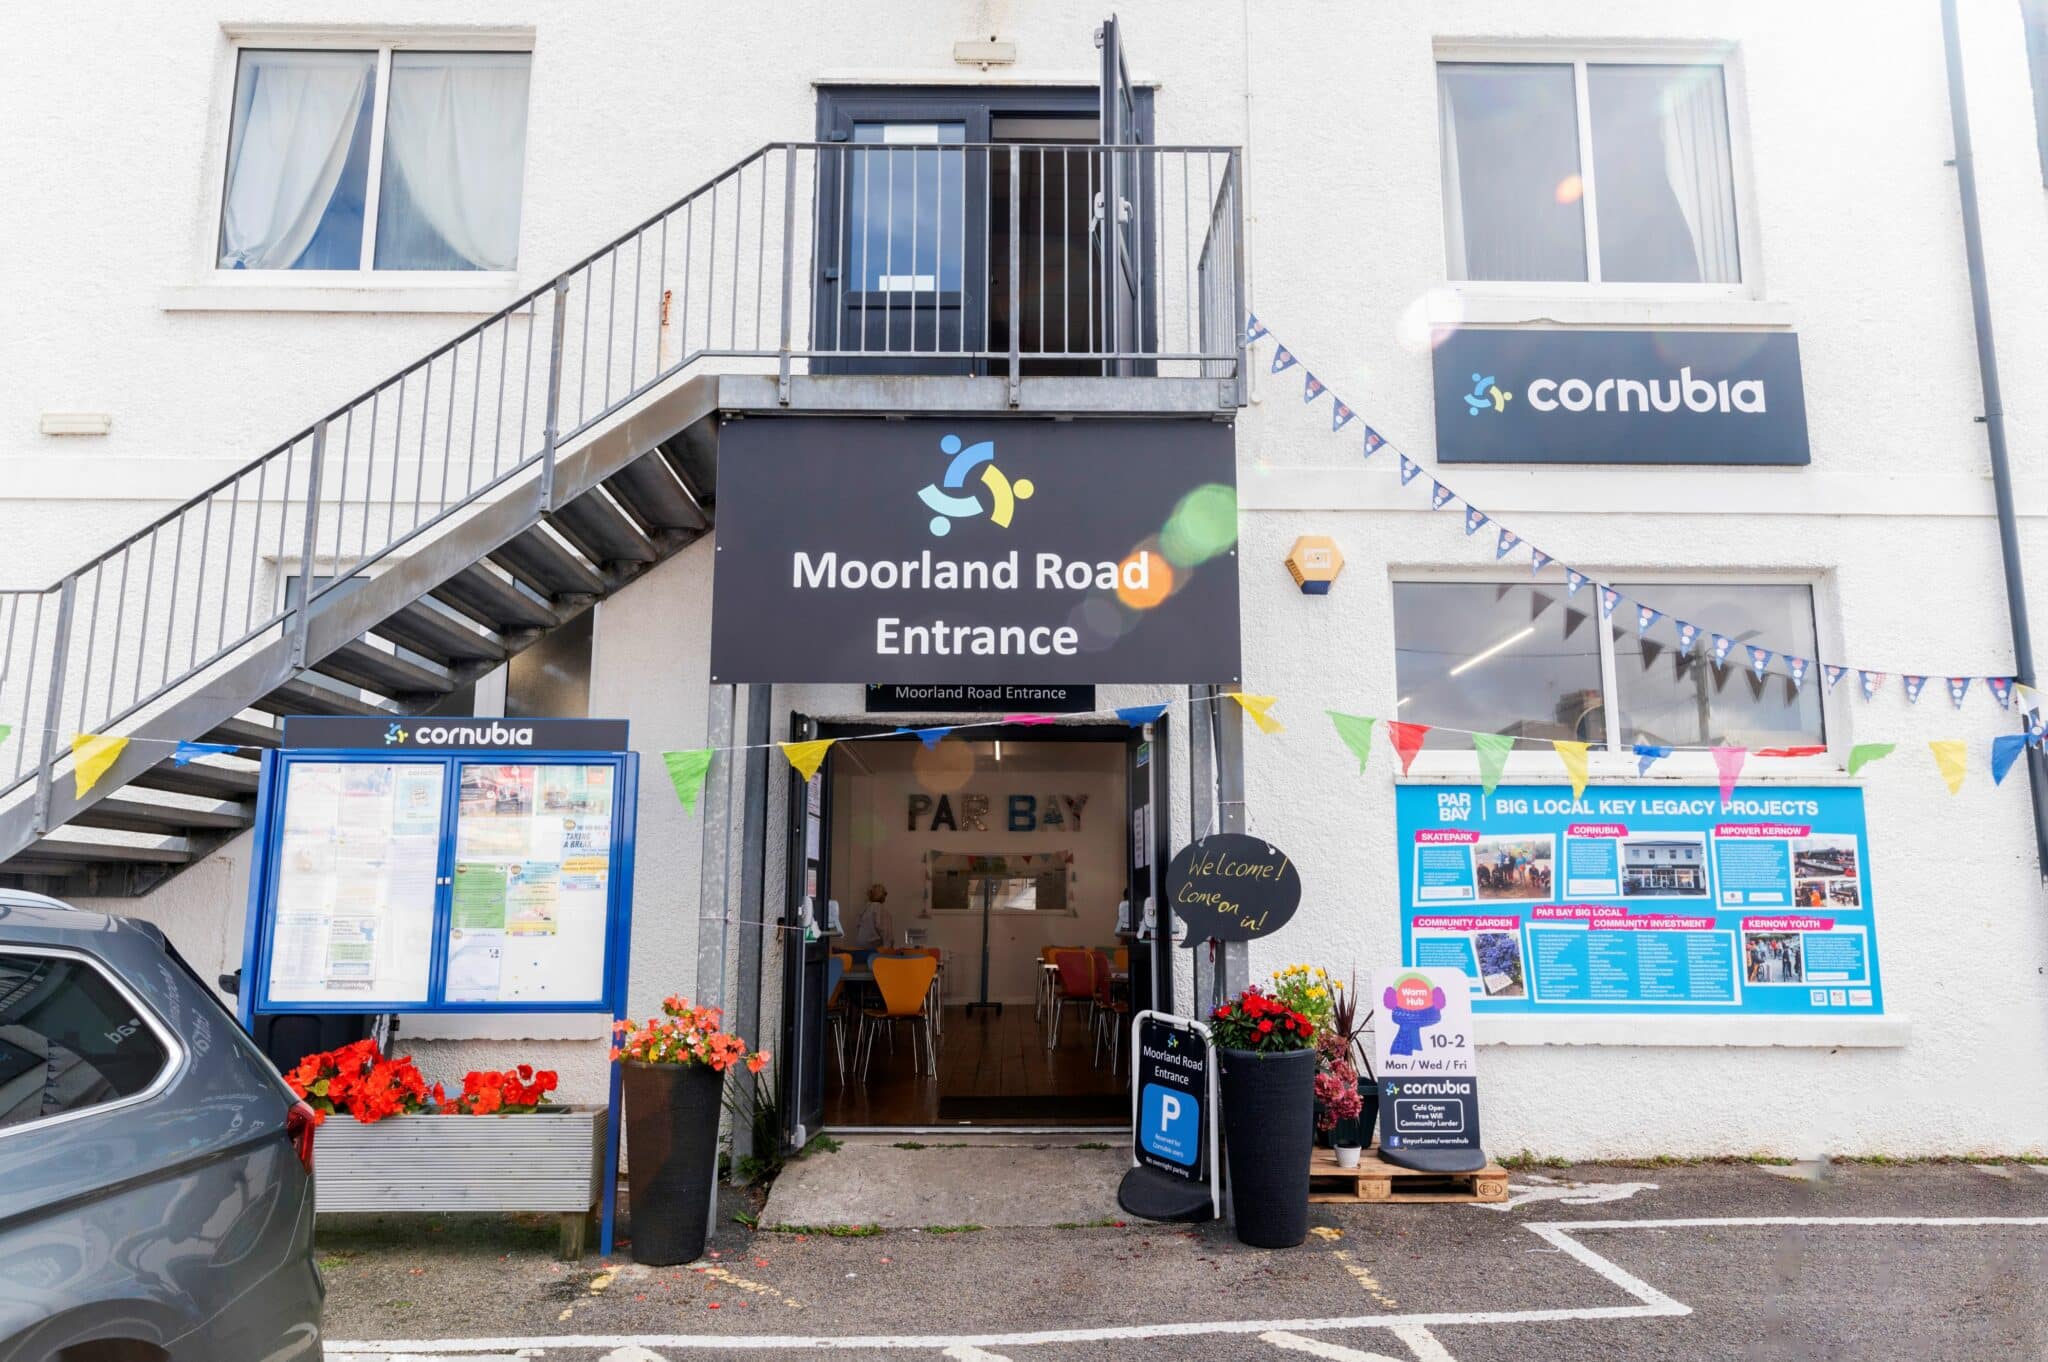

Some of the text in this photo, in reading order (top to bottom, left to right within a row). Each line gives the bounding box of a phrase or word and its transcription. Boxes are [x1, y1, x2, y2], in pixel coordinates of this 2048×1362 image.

[1527, 366, 1767, 414] cornubia
[792, 551, 1150, 590] Moorland Road
[876, 617, 1079, 656] Entrance
[895, 686, 1067, 699] Moorland Road Entrance
[415, 721, 533, 746] cornubia
[1437, 793, 1471, 807] PAR
[907, 794, 1089, 832] PAR BAY
[1439, 807, 1471, 822] BAY
[1495, 799, 1819, 816] BIG LOCAL KEY LEGACY PROJECTS
[1421, 832, 1473, 841] SKATEPARK
[1573, 826, 1620, 834] CORNUBIA
[1720, 827, 1802, 835] MPOWER KERNOW
[1188, 850, 1288, 881] Welcome!
[1178, 881, 1239, 915] Come on
[1536, 908, 1623, 917] PAR BAY BIG LOCAL
[1240, 911, 1269, 931] in!
[1418, 919, 1513, 927] COMMUNITY GARDEN
[1593, 919, 1708, 928] COMMUNITY INVESTMENT
[1748, 919, 1821, 928] KERNOW YOUTH
[1401, 988, 1428, 997] Warm
[1406, 998, 1424, 1006] Hub
[1430, 1034, 1466, 1048] 10-2
[1143, 1045, 1203, 1072] Moorland Road
[1385, 1060, 1408, 1070] Mon
[1418, 1060, 1442, 1070] Wed
[1453, 1060, 1467, 1070] Fri
[1154, 1065, 1190, 1086] Entrance
[1403, 1080, 1471, 1095] cornubia
[1161, 1094, 1181, 1132] P
[1428, 1104, 1446, 1112] Open
[1400, 1120, 1436, 1128] Community
